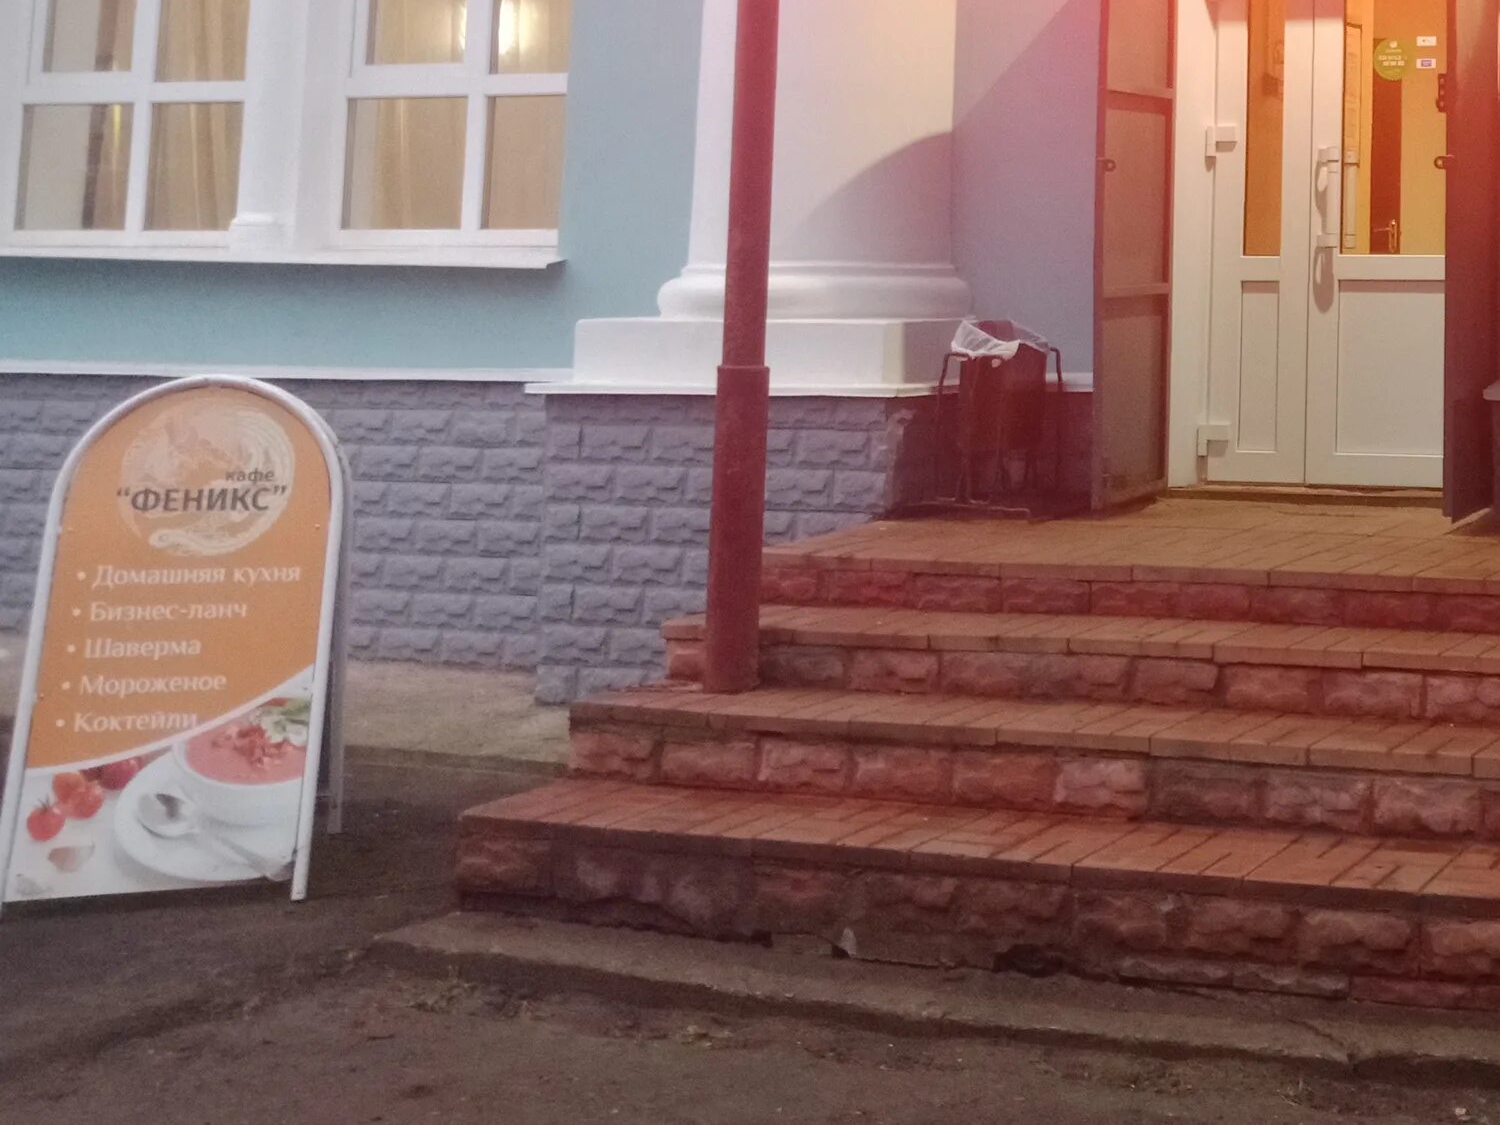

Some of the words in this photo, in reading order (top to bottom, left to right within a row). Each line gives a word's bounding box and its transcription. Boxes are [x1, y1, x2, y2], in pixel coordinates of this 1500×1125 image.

[225, 467, 275, 485] кафе
[92, 565, 226, 590] Домашняя
[233, 565, 302, 586] кухня
[90, 601, 247, 622] Бизнес-ланч
[84, 638, 202, 660] Шаверма
[80, 674, 227, 698] Мороженое
[74, 711, 198, 732] Коктейли
